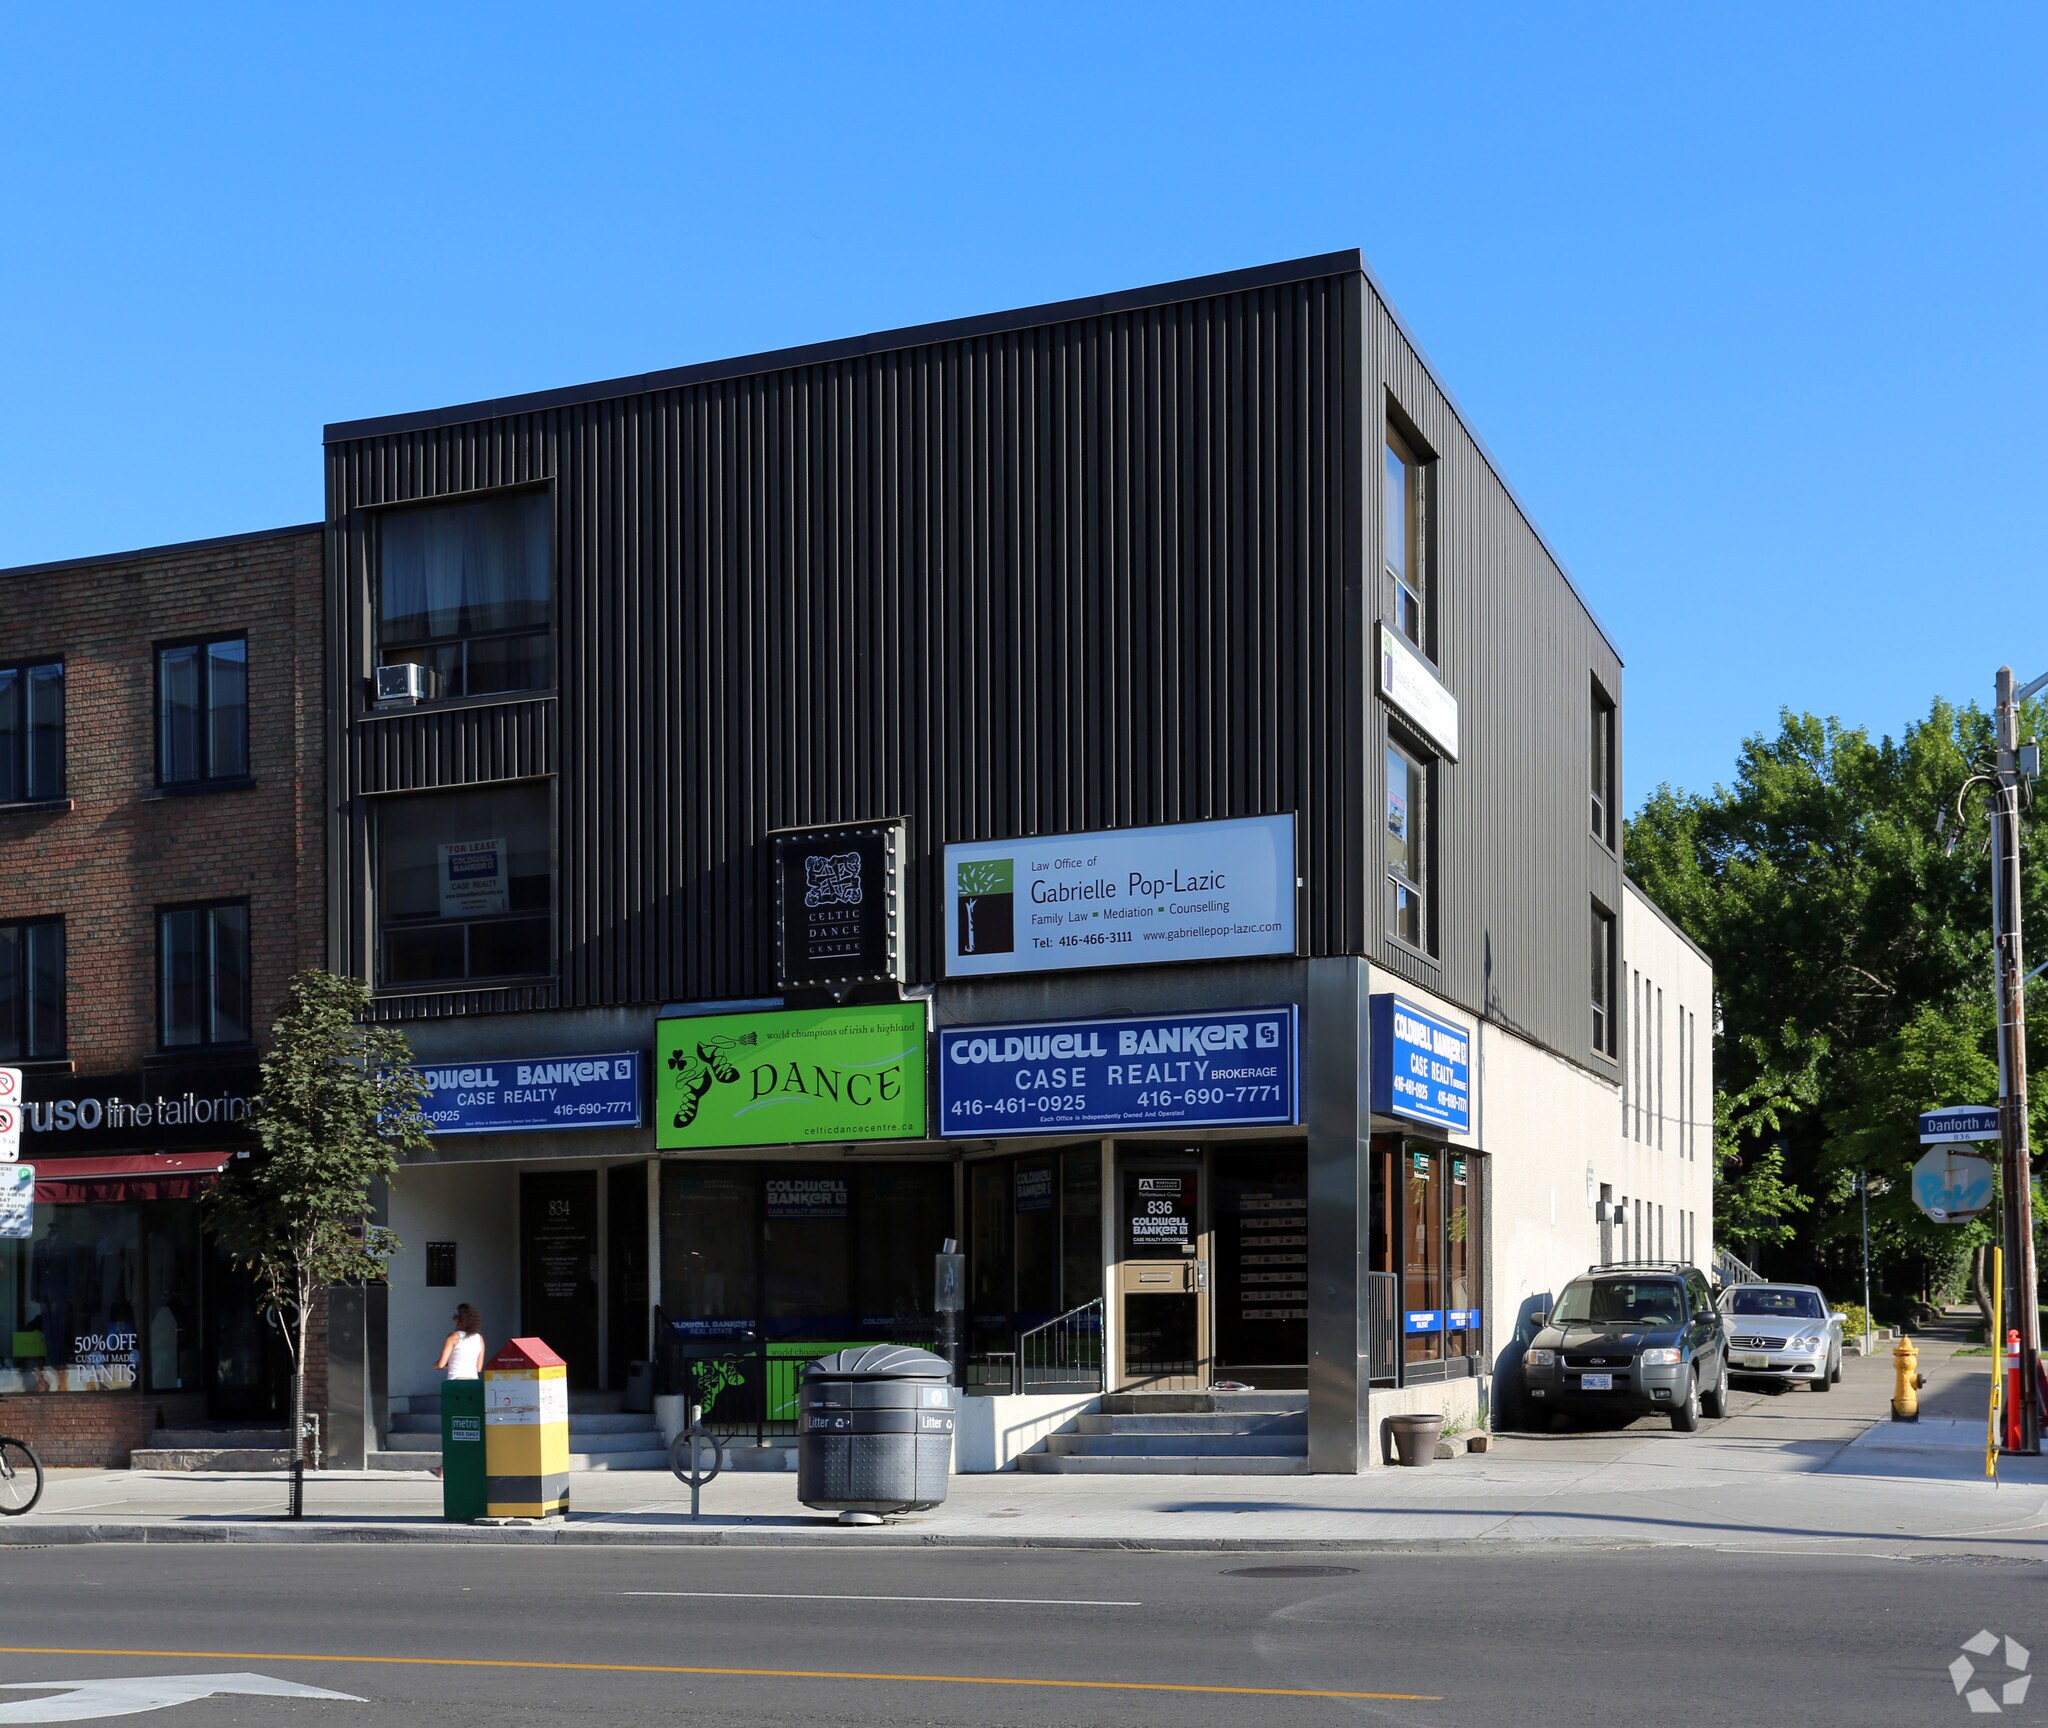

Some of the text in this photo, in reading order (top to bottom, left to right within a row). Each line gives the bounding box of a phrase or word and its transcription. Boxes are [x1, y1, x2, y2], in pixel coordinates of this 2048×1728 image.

[1031, 856, 1098, 872] Law Office of
[452, 880, 497, 891] CASE REALTY
[1031, 869, 1226, 904] Gabrielle Pop-Lazic
[809, 909, 860, 922] CELTIC
[1031, 900, 1230, 926] Family Law Mediation Counselling
[809, 925, 860, 938] DANCE
[1032, 922, 1282, 949] Tel: 416-466-3111 www.gabriellepop-lazic.com
[809, 943, 860, 953] CENTRE
[766, 1030, 790, 1040] world
[791, 1028, 837, 1040] champions
[838, 1026, 848, 1036] of
[849, 1024, 868, 1035] irish
[876, 1022, 915, 1036] highland
[950, 1032, 1108, 1065] COLDWELL
[1118, 1023, 1249, 1057] BANKER
[387, 1068, 499, 1092] LDWELL
[517, 1061, 609, 1087] BANKER
[1015, 1060, 1278, 1090] CASE REALTY BROKERAGE
[1410, 1052, 1429, 1078] CASE
[1431, 1061, 1454, 1087] REALTY
[749, 1061, 901, 1106] DANCE
[457, 1088, 558, 1106] CASE REALTY
[951, 1084, 1280, 1116] 416-461-0925 416-690-7771
[20, 1090, 263, 1133] ruso fine tailorin
[553, 1101, 632, 1117] 416-690-7771
[804, 1122, 914, 1135] celticdancecentre.ca
[1928, 1117, 1980, 1133] Danforth
[1953, 1133, 1971, 1141] 836
[766, 1180, 848, 1193] COLDWELL
[767, 1192, 833, 1207] BANKER
[549, 1200, 570, 1216] 834
[1147, 1200, 1173, 1215] 836
[1132, 1217, 1189, 1226] COLDWELL
[1132, 1226, 1178, 1236] BANKER
[672, 1320, 748, 1330] OLDWELL BANKER
[708, 1327, 733, 1335] ESTATE
[106, 1333, 137, 1351] OFF
[75, 1353, 135, 1363] CUSTOM MADE
[771, 1348, 793, 1356] world
[76, 1363, 137, 1383] PANTS
[453, 1418, 479, 1429] metro
[808, 1416, 830, 1429] Litter
[922, 1415, 942, 1429] Litter
